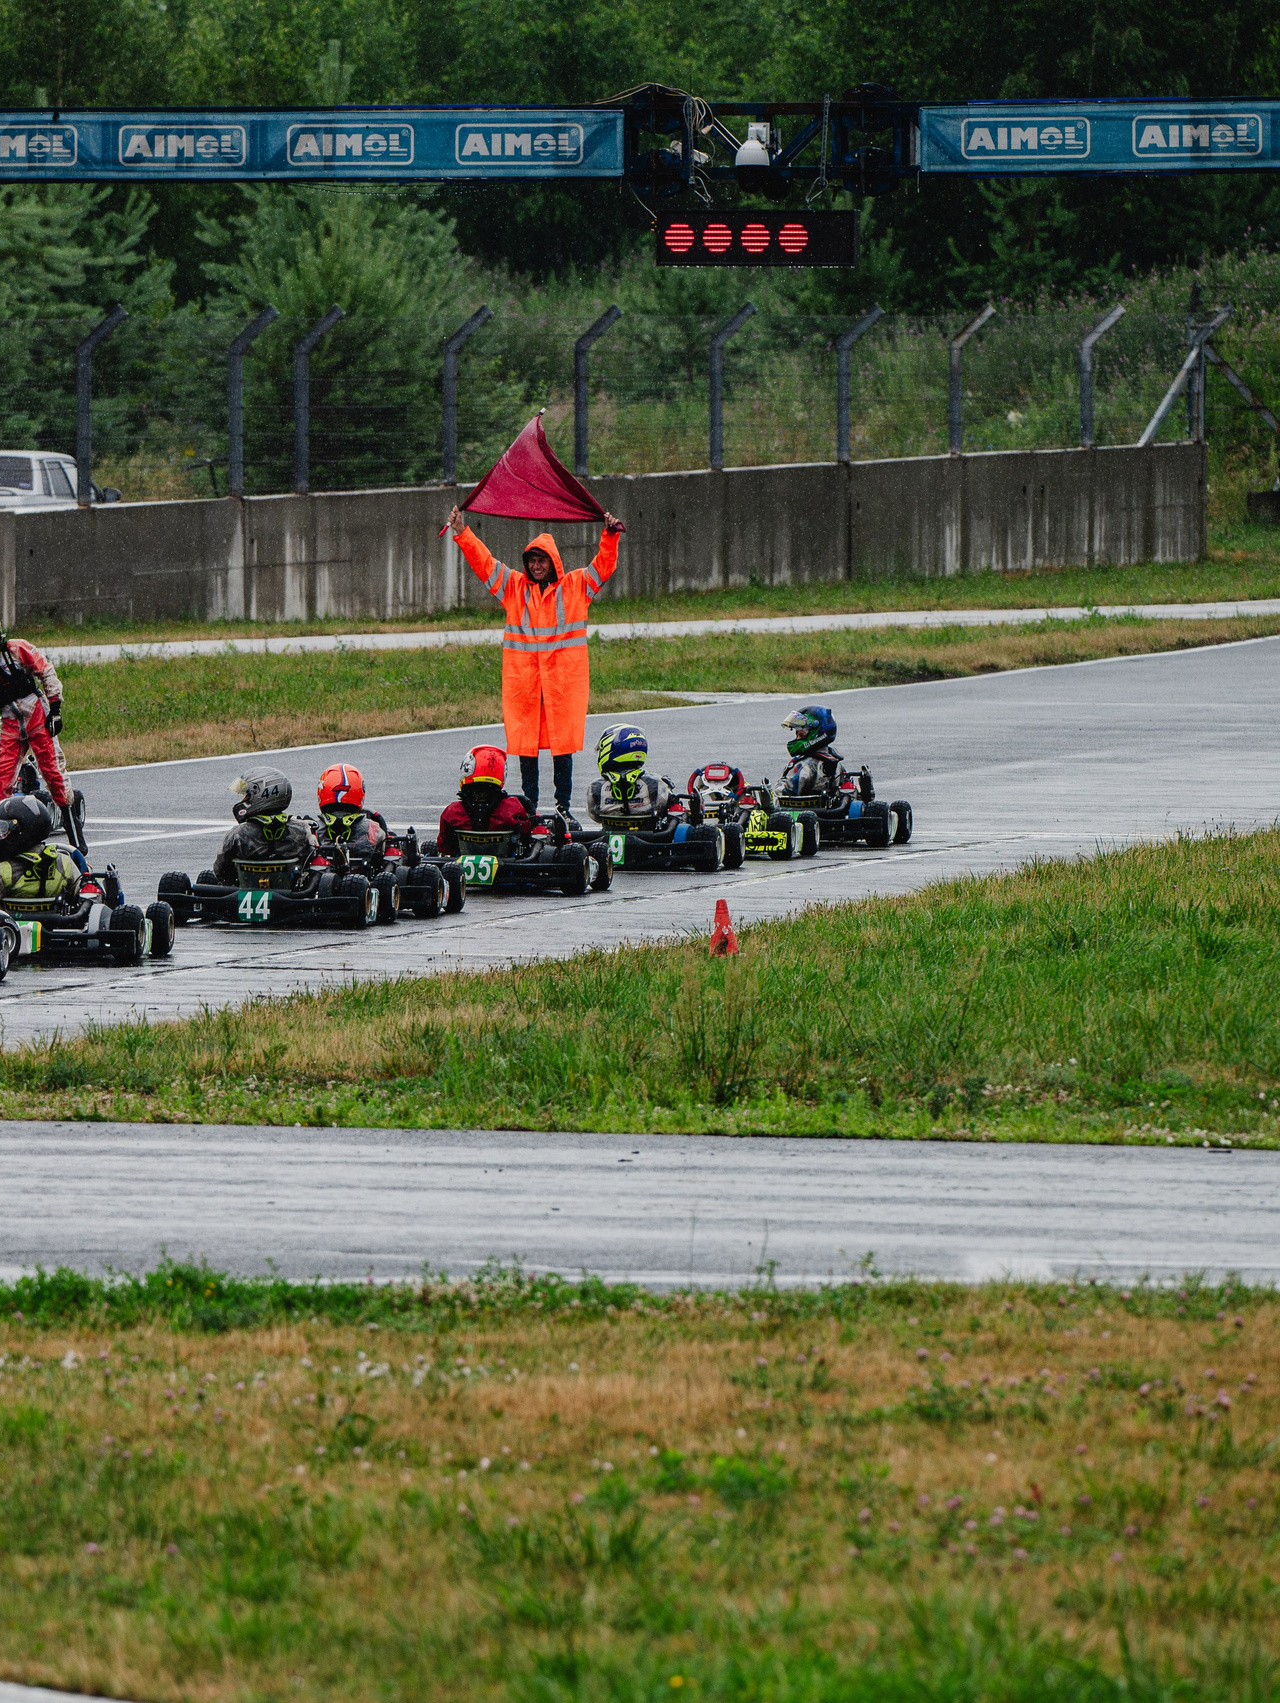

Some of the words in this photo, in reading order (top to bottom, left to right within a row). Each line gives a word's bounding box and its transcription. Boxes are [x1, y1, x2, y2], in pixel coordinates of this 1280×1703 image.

[125, 135, 239, 157] AIMOL
[294, 134, 407, 156] AIMOL
[462, 134, 576, 155] AIMOL
[968, 127, 1083, 150] AIMOL
[1139, 124, 1255, 147] AIMOL
[261, 785, 280, 799] 44
[610, 835, 624, 862] 9
[462, 856, 491, 881] 55
[238, 891, 270, 920] 44
